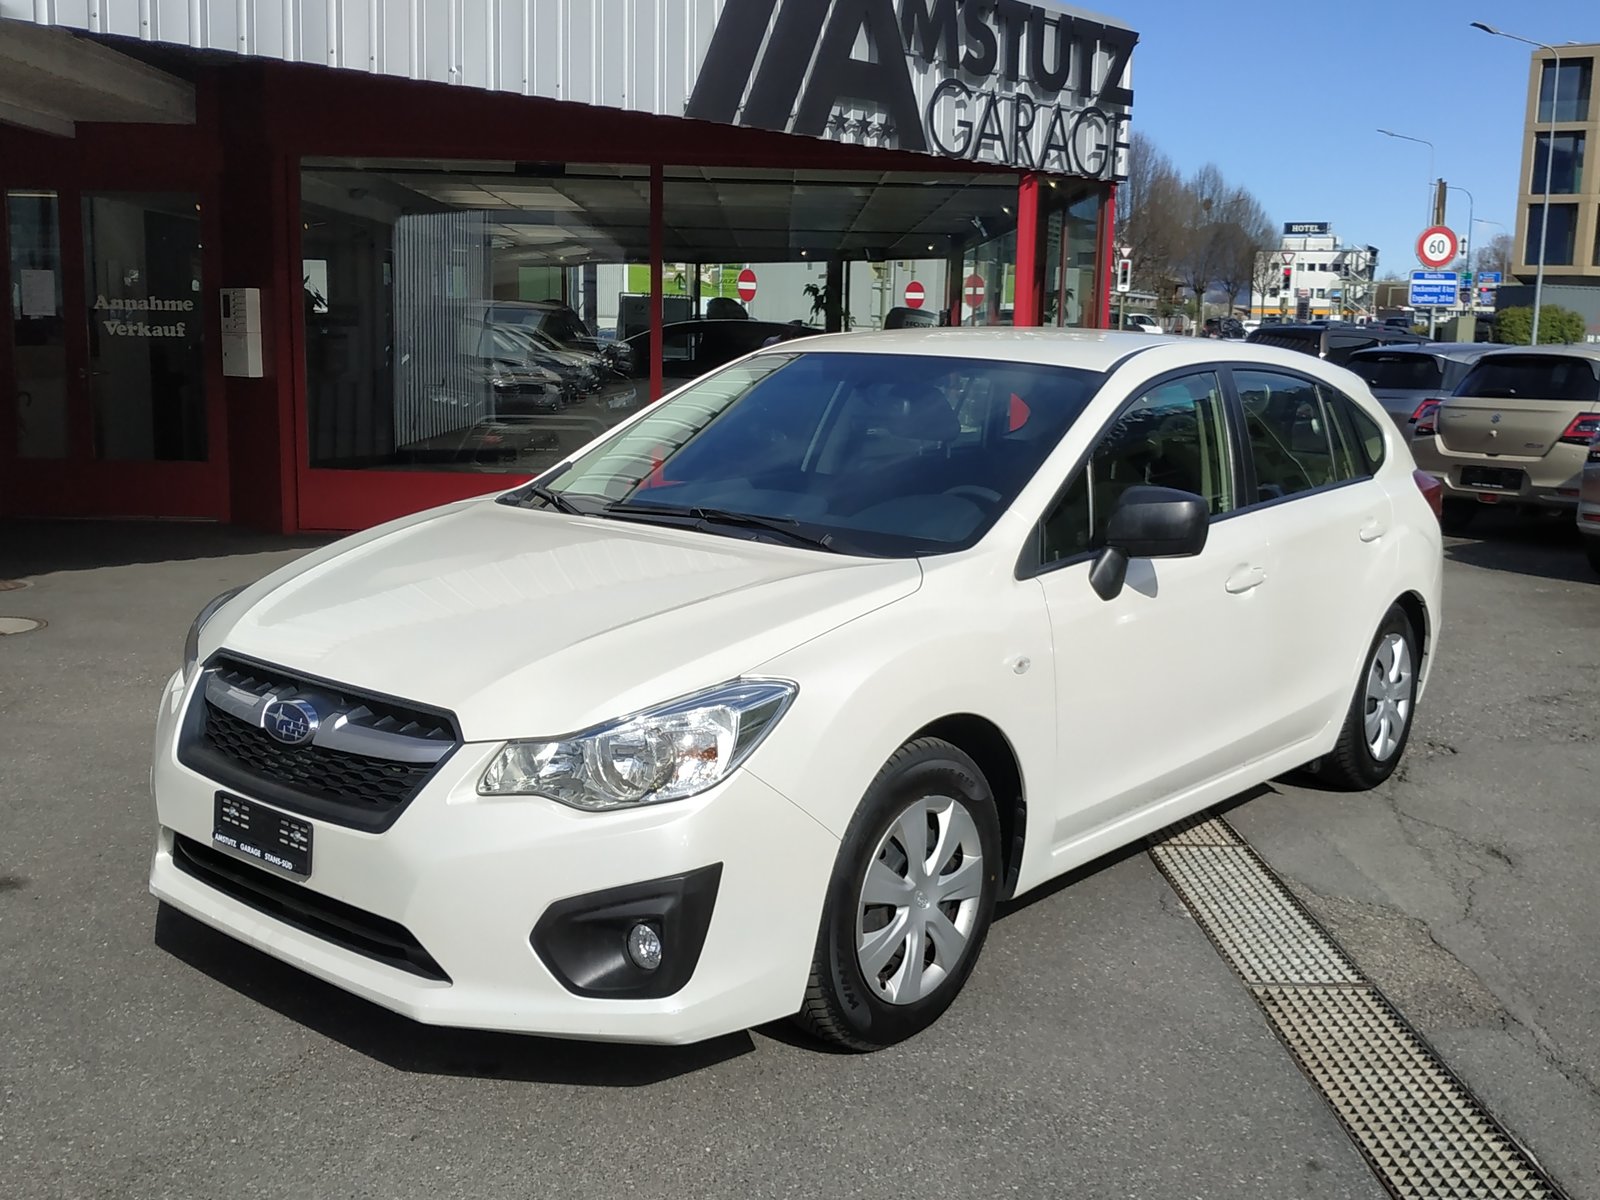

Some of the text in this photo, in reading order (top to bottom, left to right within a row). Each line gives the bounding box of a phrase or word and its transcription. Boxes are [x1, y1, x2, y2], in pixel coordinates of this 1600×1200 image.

[793, 0, 1140, 152] AMSTUTZ
[928, 78, 1132, 181] GARAGE
[1291, 225, 1320, 233] HOTEL
[1429, 240, 1445, 254] 60
[93, 294, 194, 311] Annahme
[103, 320, 186, 337] Verkauf
[905, 320, 938, 329] HOND
[214, 832, 237, 848] AMSTUTZ
[240, 842, 262, 858] GARAGE
